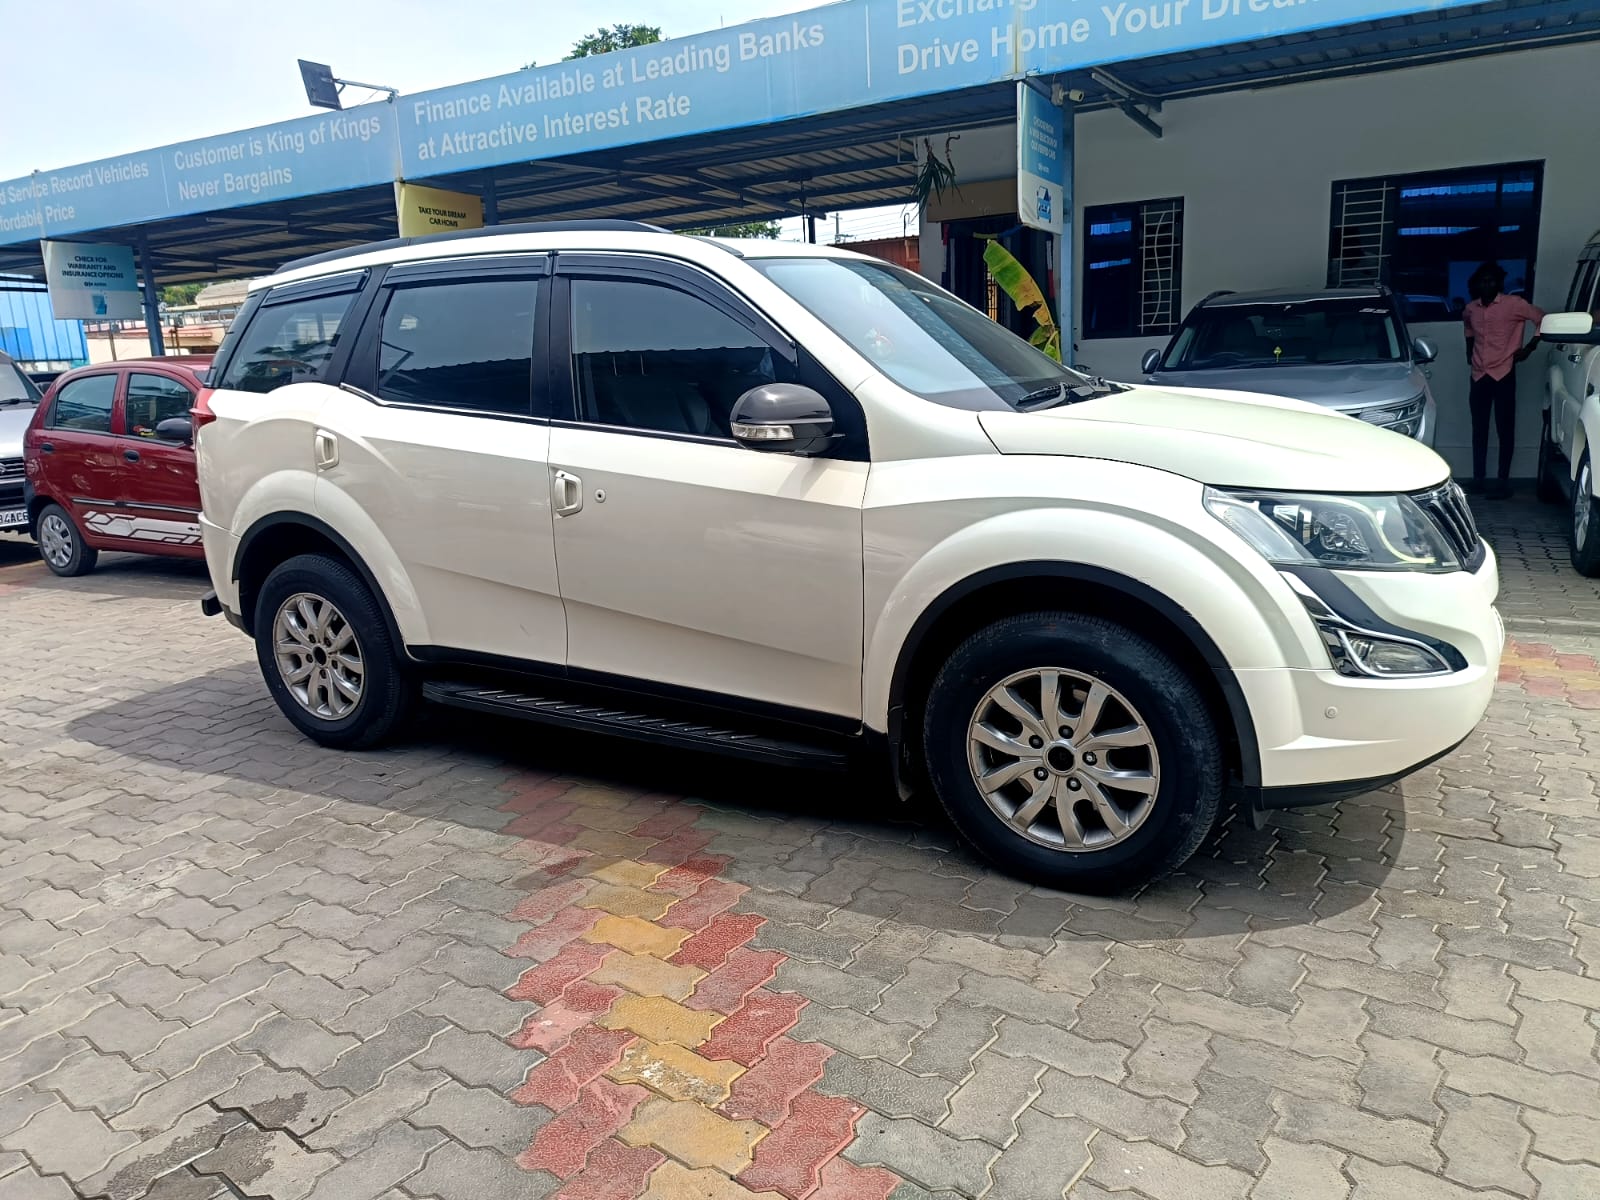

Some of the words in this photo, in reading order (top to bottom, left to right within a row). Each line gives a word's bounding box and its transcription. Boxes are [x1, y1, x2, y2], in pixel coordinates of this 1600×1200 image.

[897, 37, 979, 75] Drive
[991, 17, 1090, 58] Home
[1101, 0, 1191, 37] Your
[414, 93, 491, 125] Finance
[497, 68, 595, 109] Available
[602, 61, 625, 89] at
[631, 43, 730, 84] Leading
[738, 21, 825, 62] Banks
[174, 142, 244, 170] Customer
[249, 136, 263, 157] is
[266, 131, 305, 154] King
[309, 121, 325, 145] of
[329, 116, 381, 142] Kings
[418, 136, 436, 161] at
[440, 121, 538, 156] Attractive
[543, 100, 630, 139] Interest
[636, 91, 691, 123] Rate
[7, 182, 49, 203] Service
[50, 168, 94, 195] Record
[95, 160, 149, 185] Vehicles
[178, 178, 219, 201] Never
[223, 165, 293, 194] Bargains
[45, 204, 75, 223] Price
[418, 206, 432, 215] TAKE
[432, 208, 447, 217] YOUR
[429, 217, 441, 226] CAR
